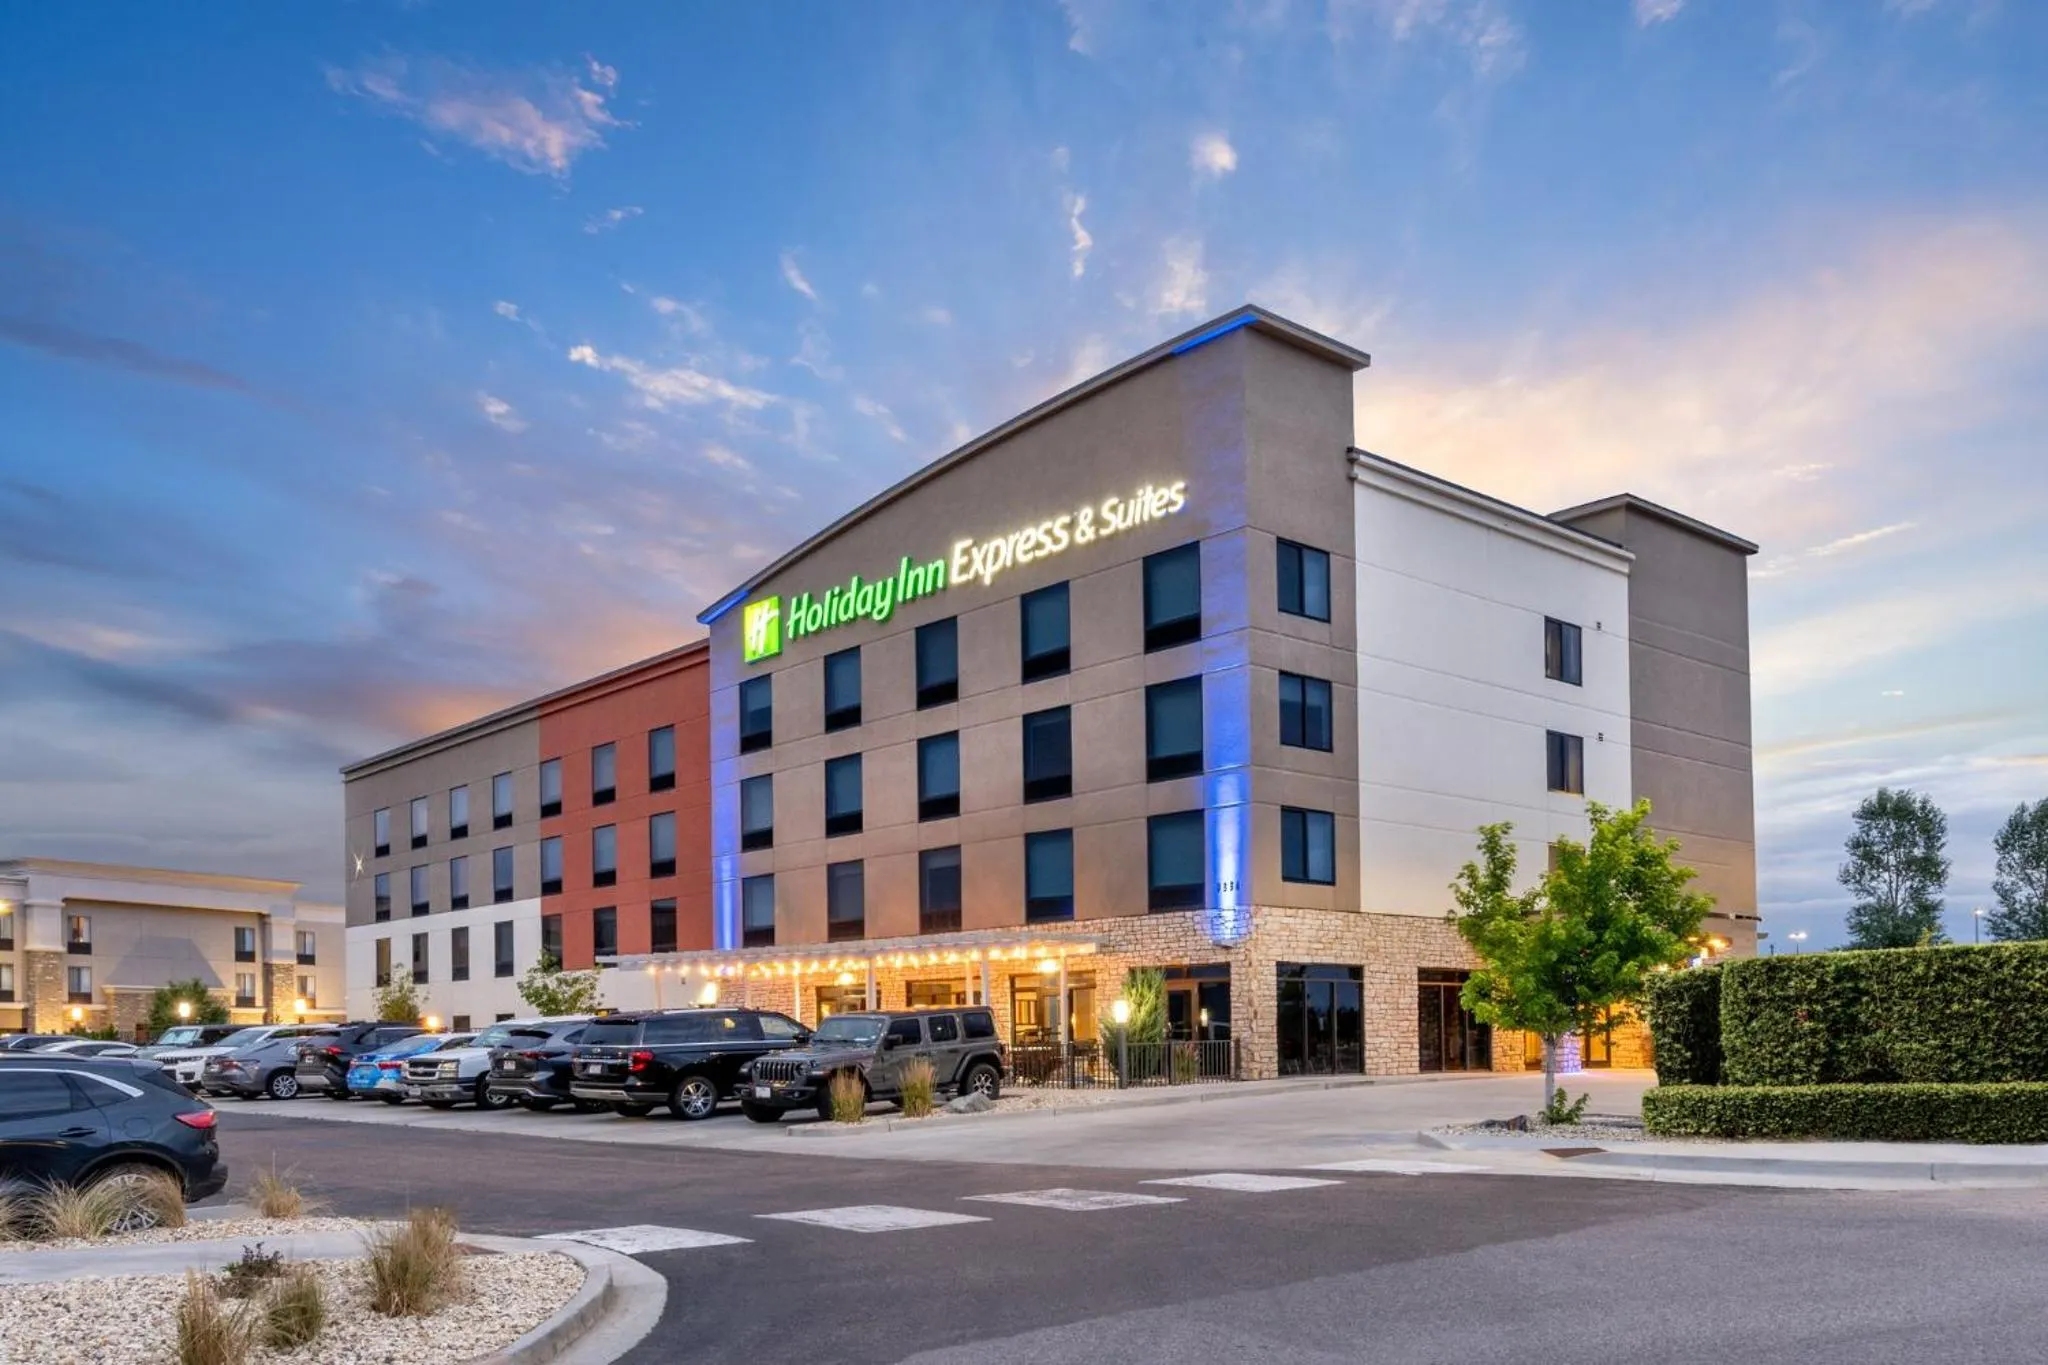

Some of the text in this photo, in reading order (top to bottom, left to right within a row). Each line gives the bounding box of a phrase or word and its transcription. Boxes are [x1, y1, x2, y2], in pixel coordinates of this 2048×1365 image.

[787, 575, 894, 640] Holiday
[897, 556, 946, 603] Inn
[950, 515, 1071, 586] Express
[1074, 506, 1096, 544] &
[1099, 481, 1187, 536] Suites
